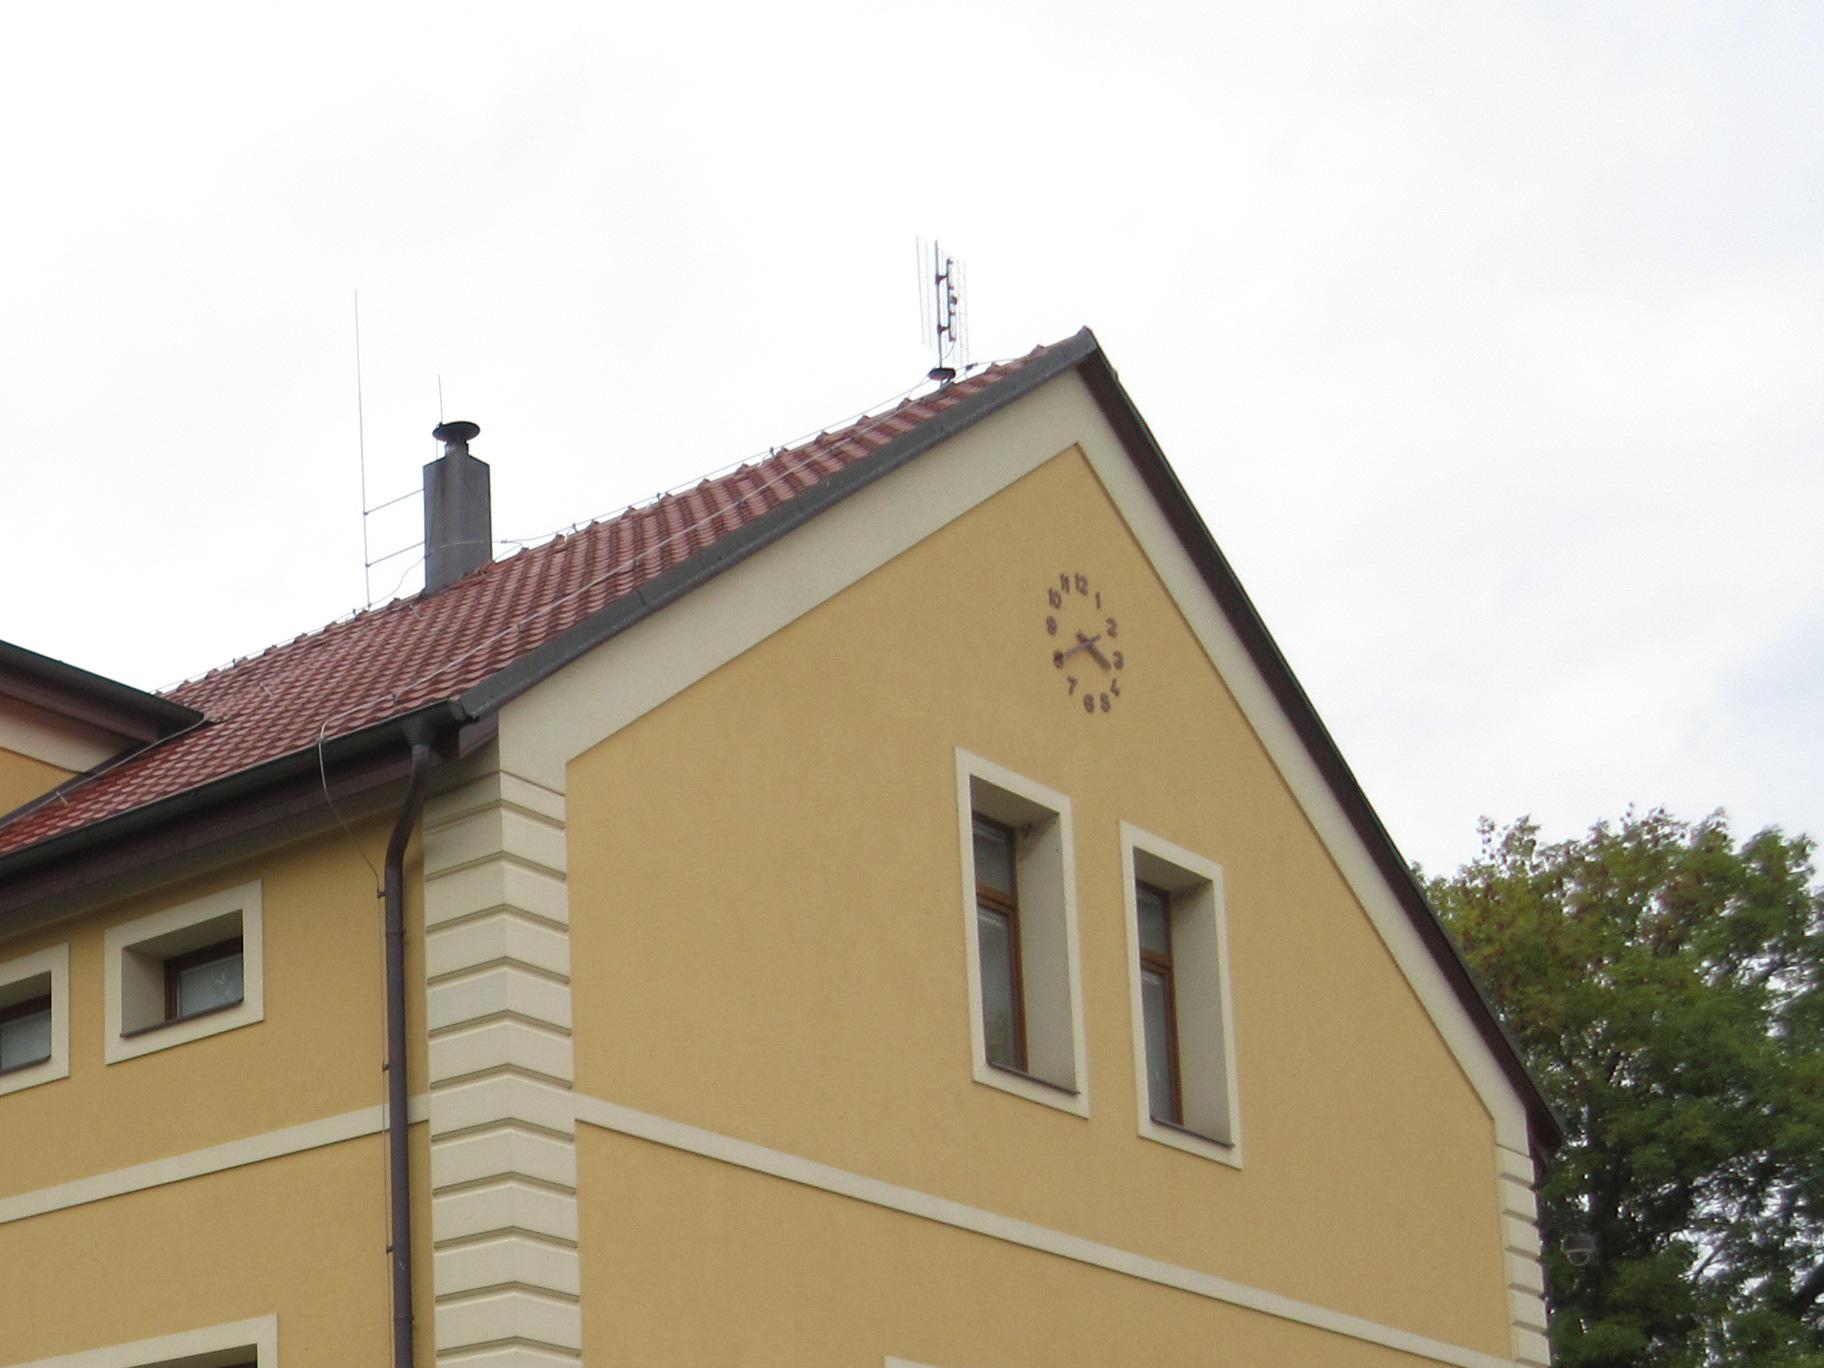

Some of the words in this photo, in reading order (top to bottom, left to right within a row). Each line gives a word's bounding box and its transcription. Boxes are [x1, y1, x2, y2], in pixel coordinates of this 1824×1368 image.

[1074, 572, 1089, 596] 12
[1047, 587, 1062, 610] 10
[1094, 591, 1102, 610] 1
[1105, 617, 1118, 639] 2
[1112, 650, 1125, 671] 3
[1066, 675, 1078, 696] 7
[1110, 678, 1121, 698] 4
[1083, 693, 1095, 714] 6
